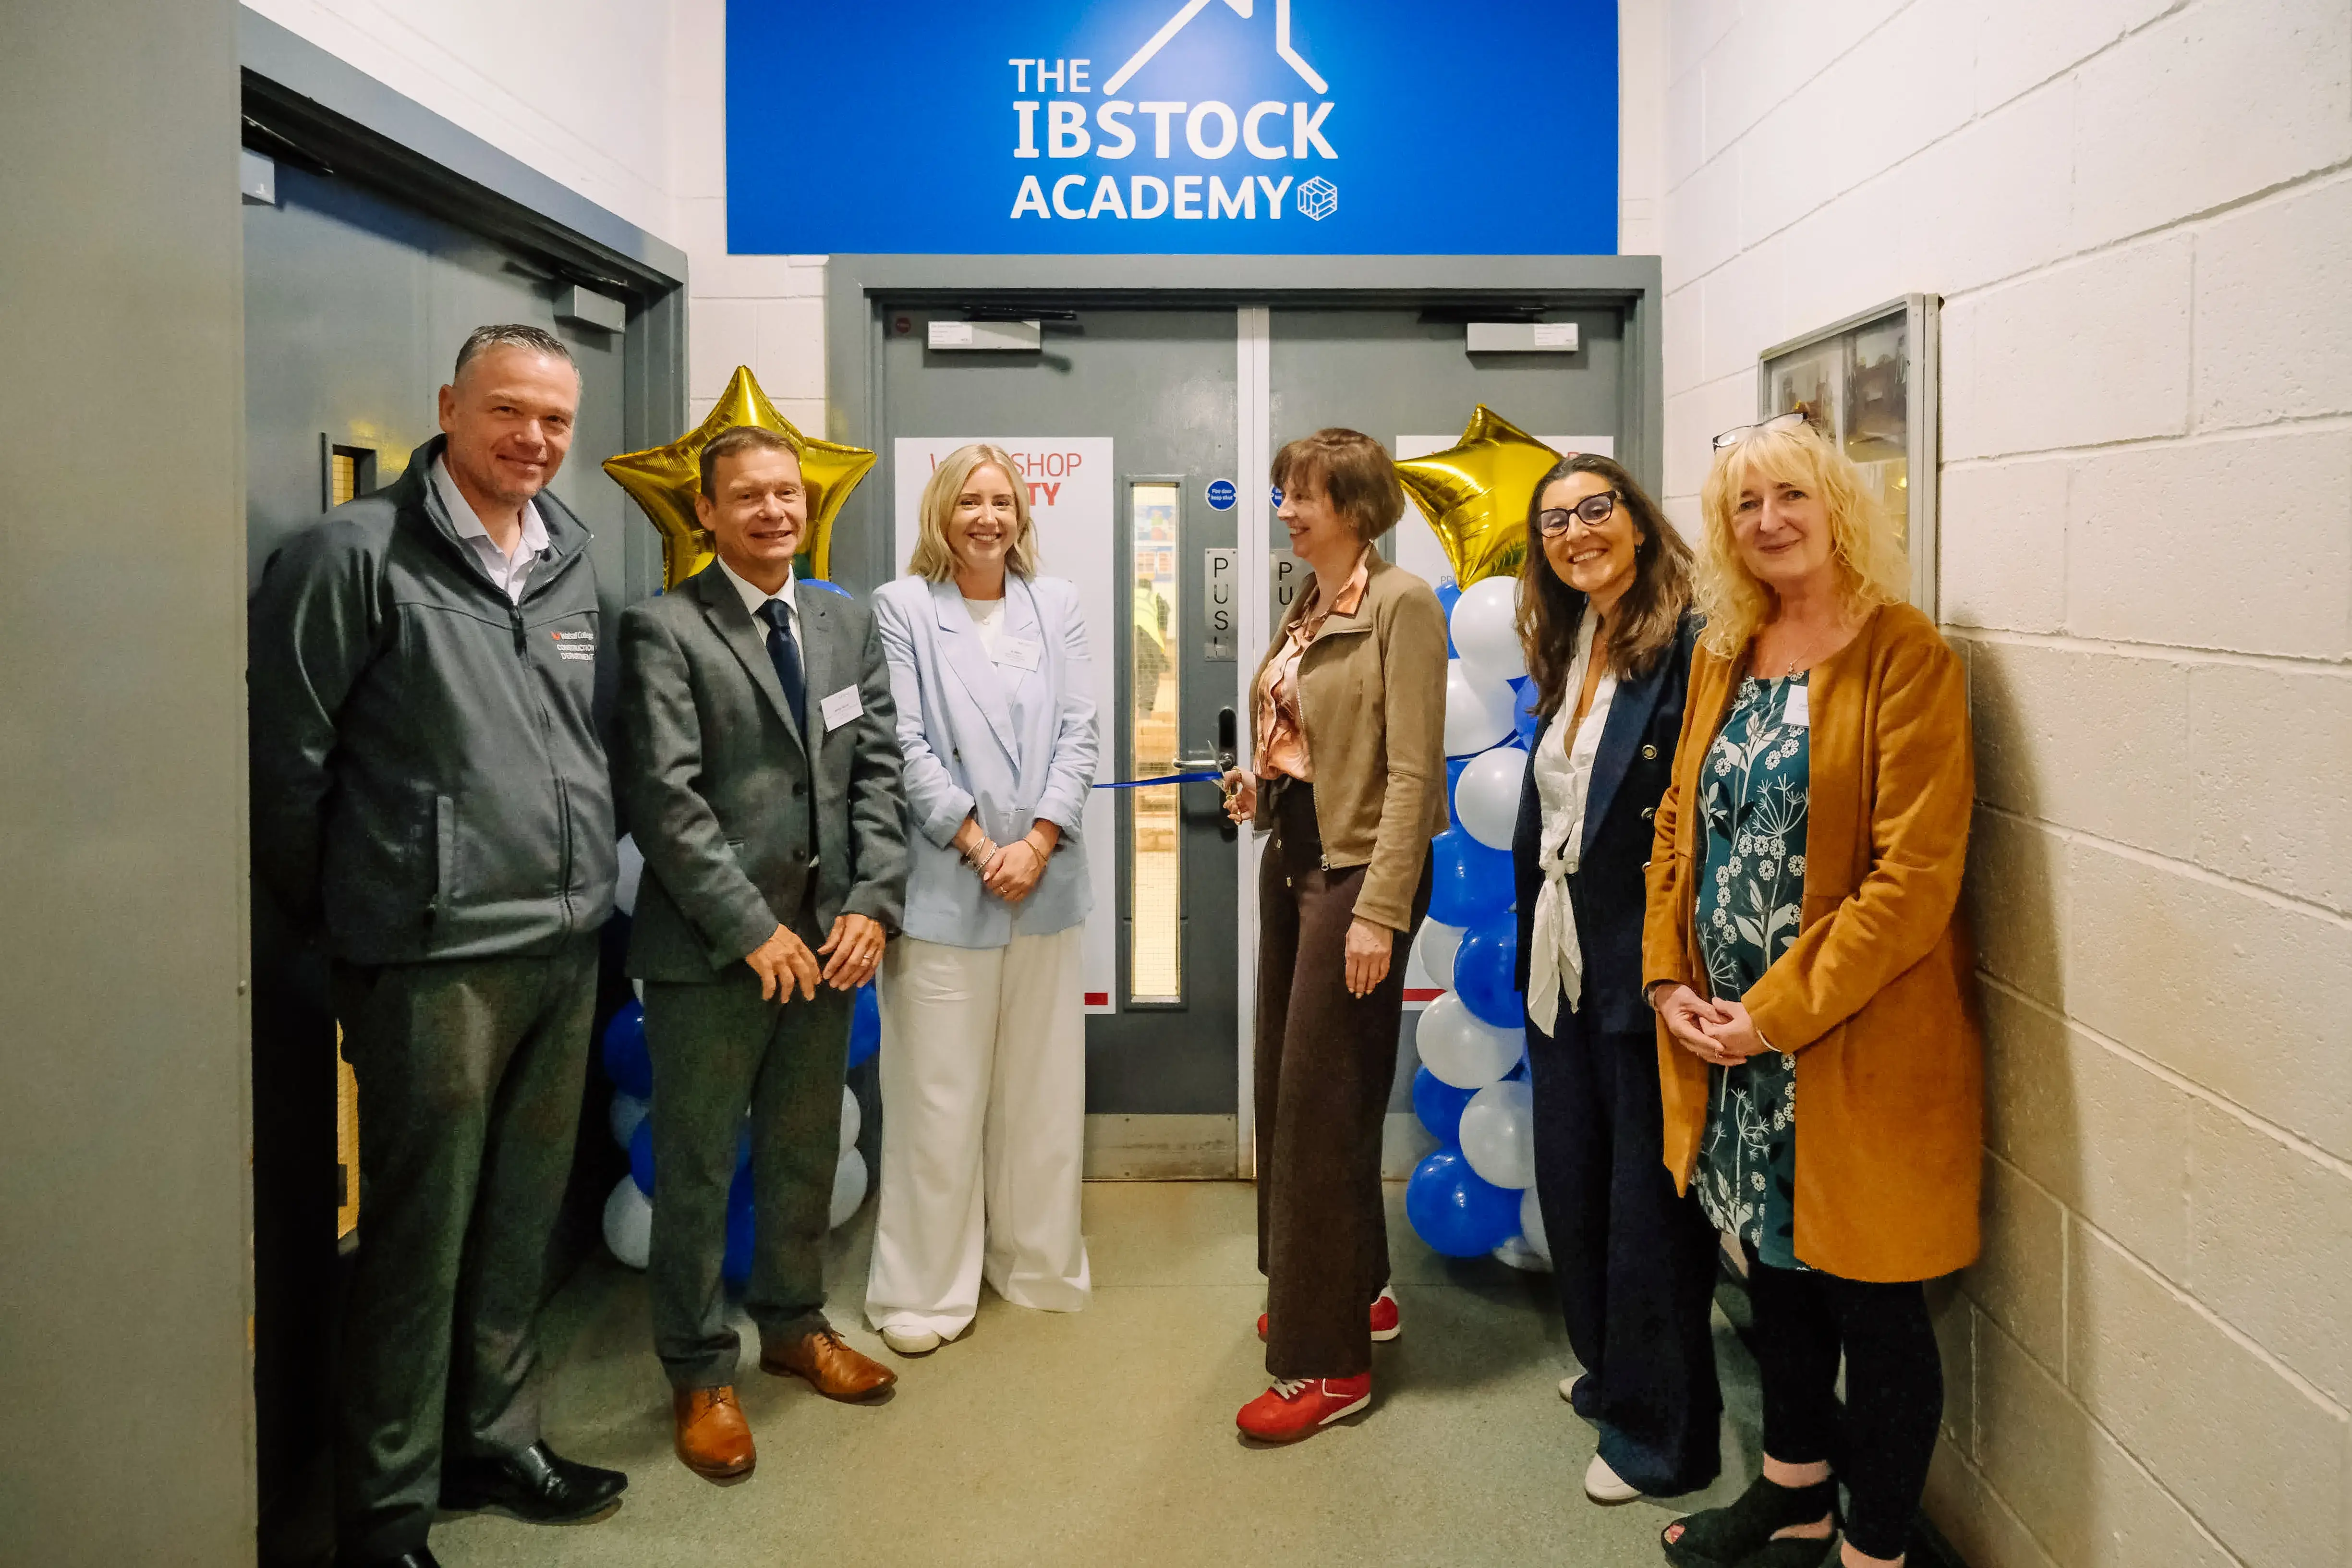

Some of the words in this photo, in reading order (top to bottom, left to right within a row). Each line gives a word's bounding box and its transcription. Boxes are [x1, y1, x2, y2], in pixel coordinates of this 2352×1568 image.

[1008, 59, 1091, 93] THE
[1013, 100, 1338, 160] IBSTOCK
[1010, 175, 1294, 220] ACADEMY
[930, 453, 1082, 477] SHOP
